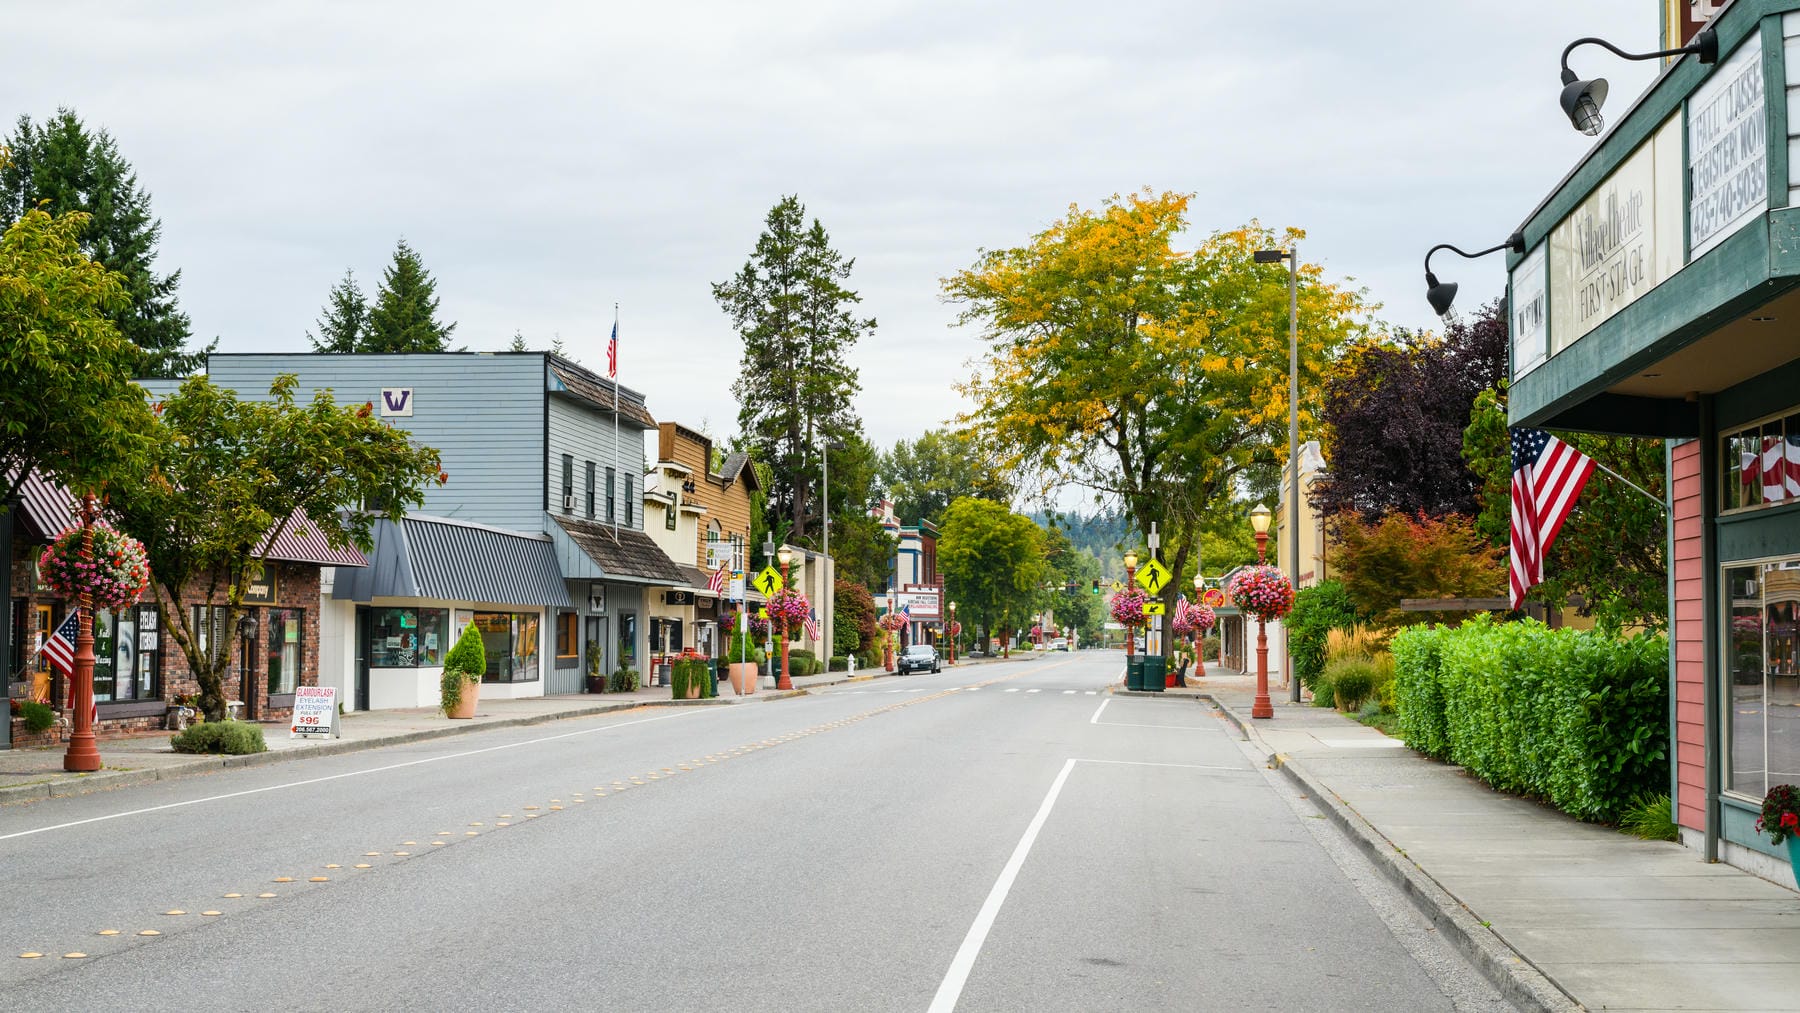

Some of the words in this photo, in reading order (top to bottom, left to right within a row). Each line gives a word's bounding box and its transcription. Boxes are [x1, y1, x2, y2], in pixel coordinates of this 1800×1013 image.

[1697, 94, 1721, 152] FALL
[1740, 105, 1765, 160] NOW
[1693, 153, 1766, 241] 425-740-5035
[1577, 213, 1608, 271] Village
[1606, 183, 1643, 251] Theatre
[1580, 272, 1606, 322] FIRST
[1609, 244, 1645, 302] STAGE
[383, 391, 410, 411] W
[140, 611, 157, 629] EYELASH
[297, 688, 334, 697] GLAMOURLASH
